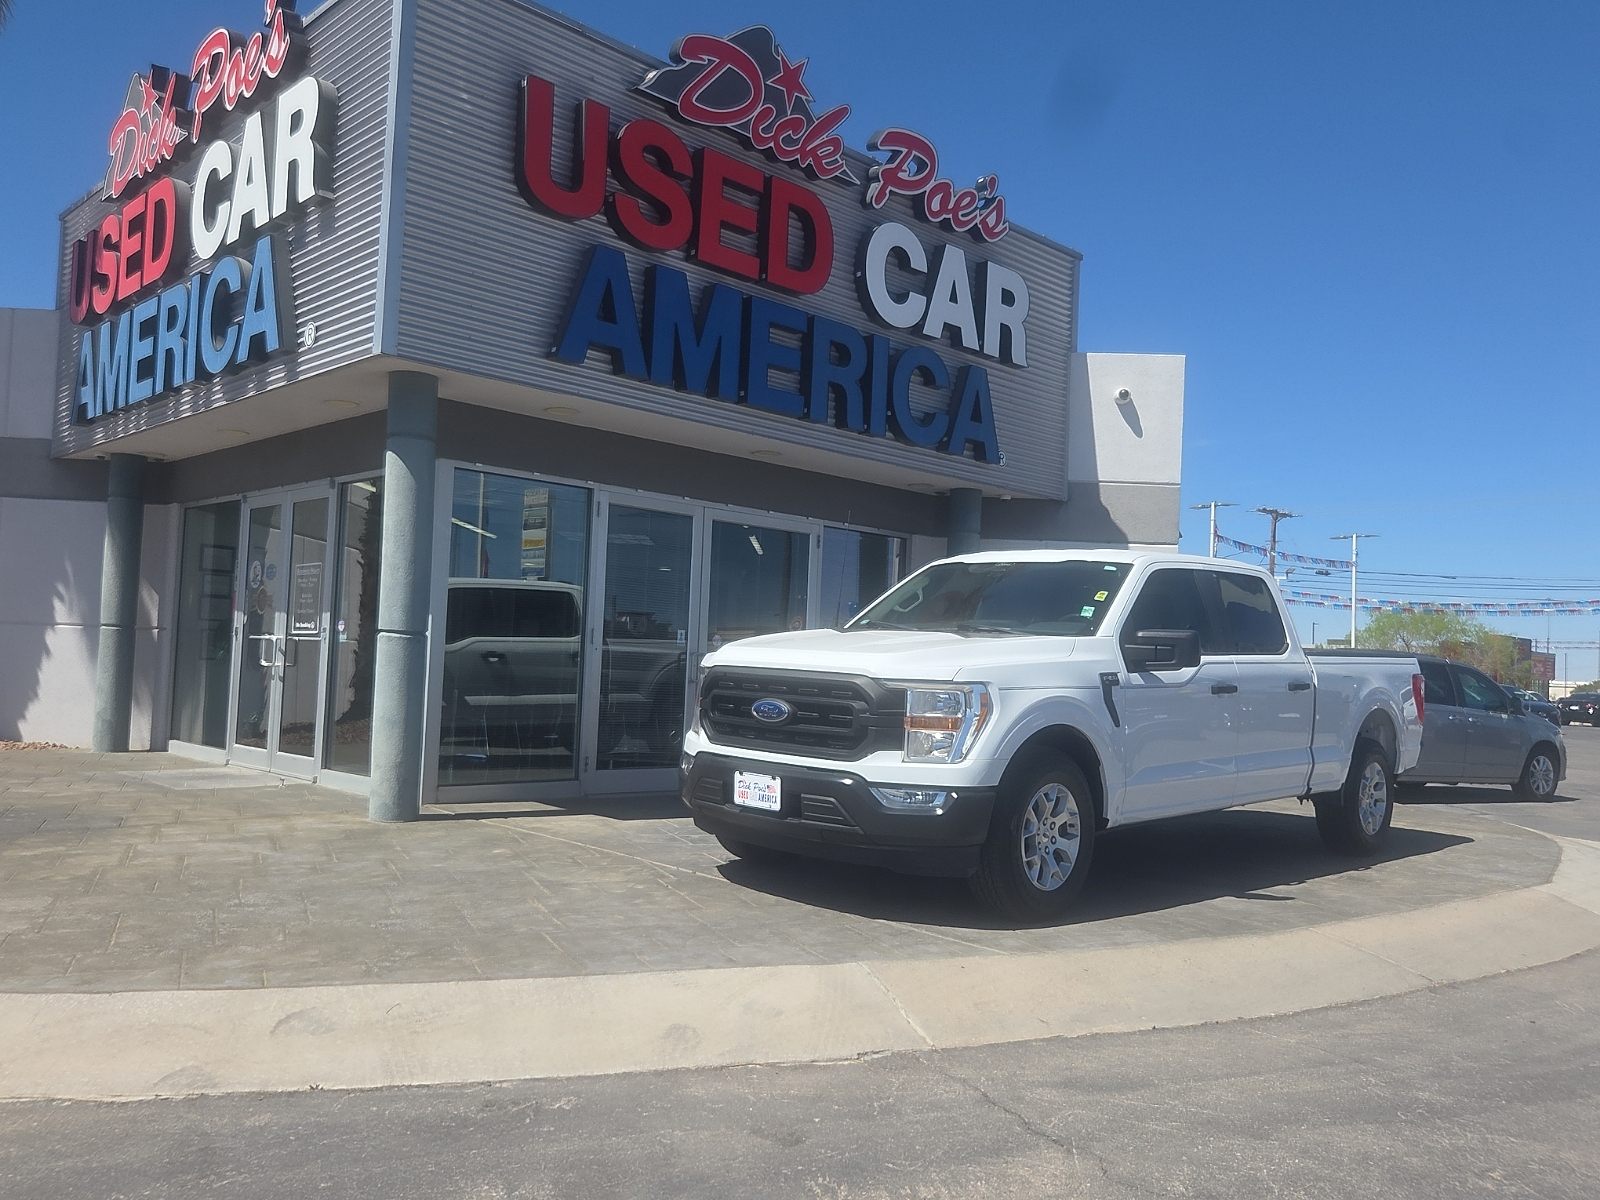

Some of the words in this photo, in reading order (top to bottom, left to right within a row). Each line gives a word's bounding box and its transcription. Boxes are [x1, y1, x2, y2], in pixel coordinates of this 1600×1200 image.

[71, 177, 177, 325] USED
[191, 76, 319, 260] CAR
[108, 71, 179, 198] Dick
[520, 74, 835, 296] USED
[864, 222, 1031, 369] CAR
[676, 33, 852, 180] Dick
[868, 127, 1009, 243] Poe's
[76, 236, 280, 421] AMERICA
[554, 243, 1000, 465] AMERICA
[758, 704, 779, 718] Ford
